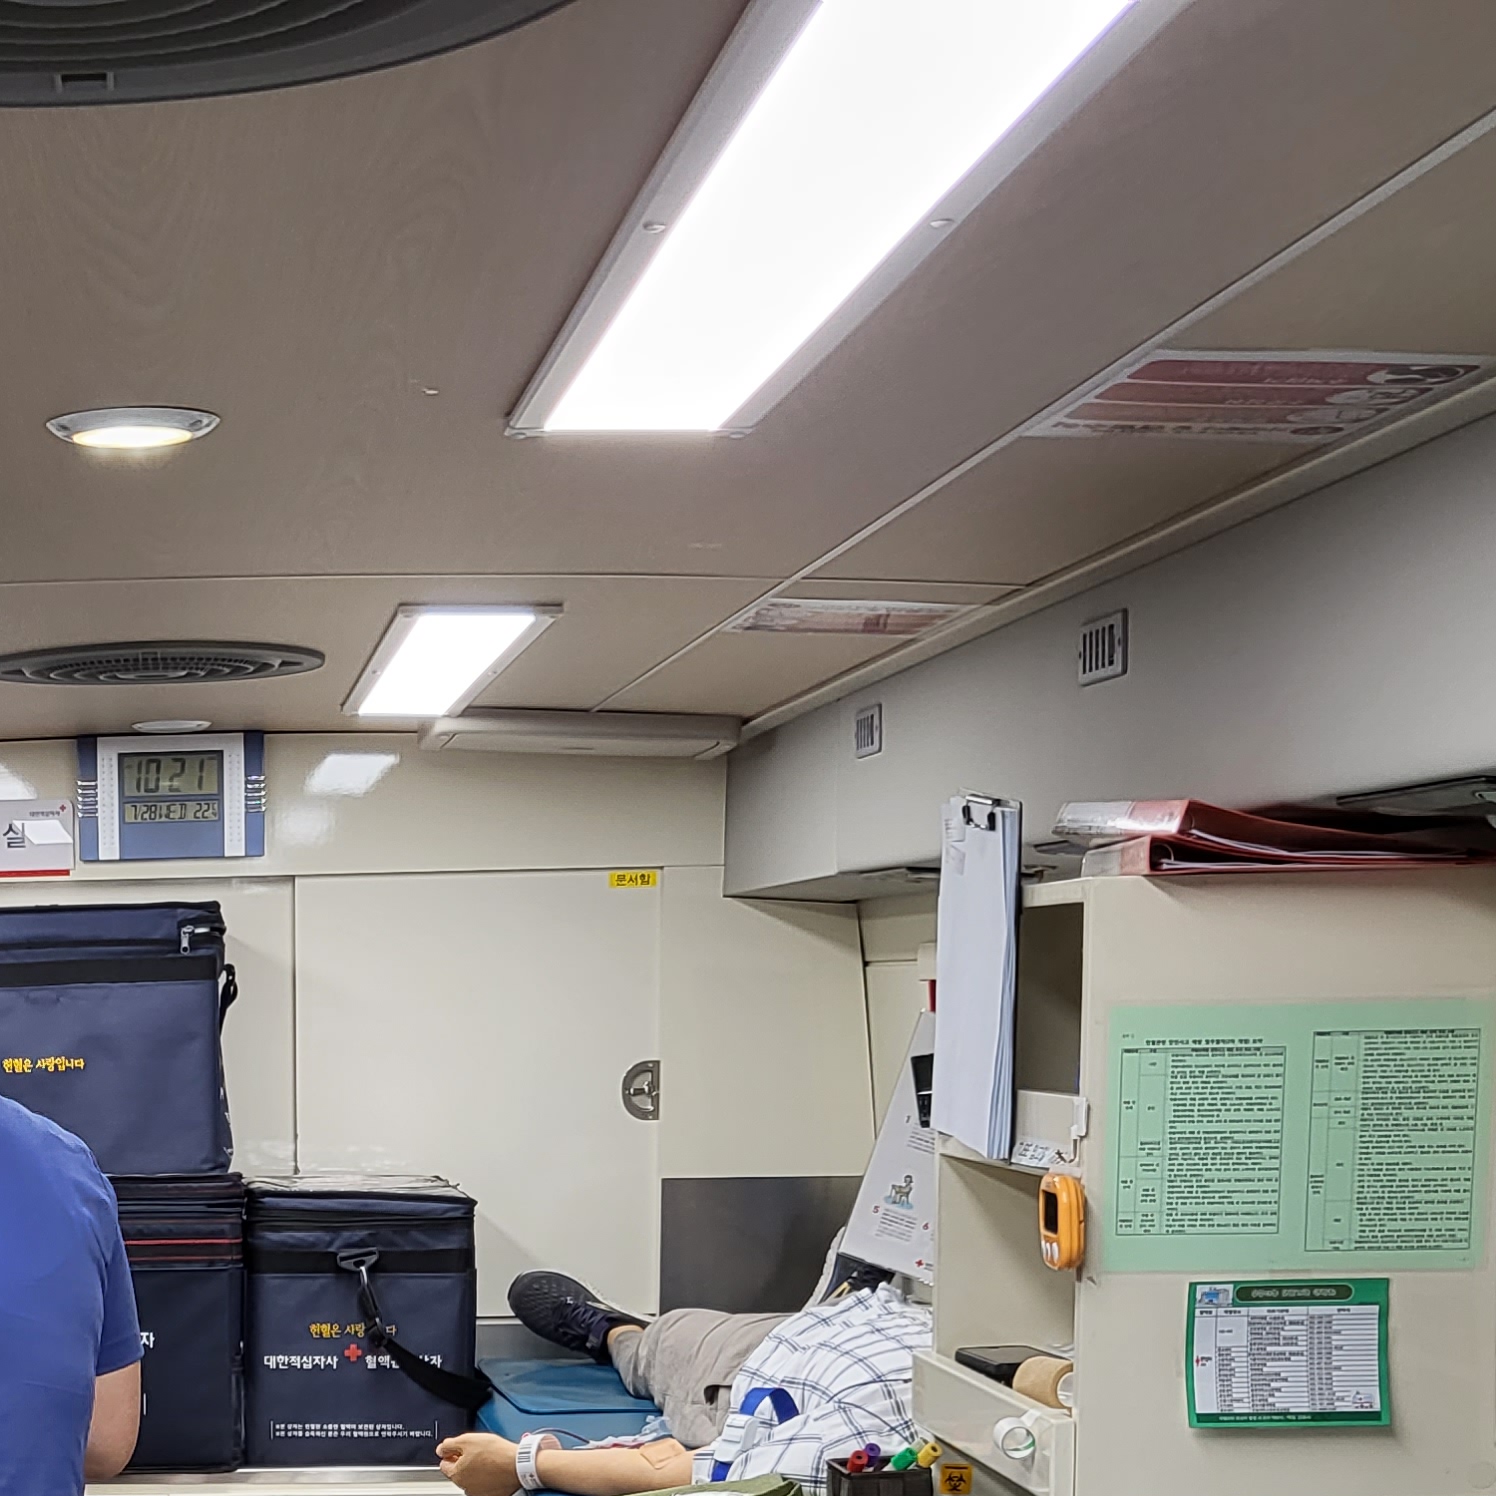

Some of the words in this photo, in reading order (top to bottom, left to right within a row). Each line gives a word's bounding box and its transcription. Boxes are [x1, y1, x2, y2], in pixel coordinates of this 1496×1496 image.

[3, 1058, 33, 1073] 헌혈은
[35, 1056, 85, 1072] 사랑입니다
[309, 1323, 341, 1338] 헌혈은
[344, 1323, 397, 1338] 사랑다
[263, 1355, 338, 1370] 대한적십자사
